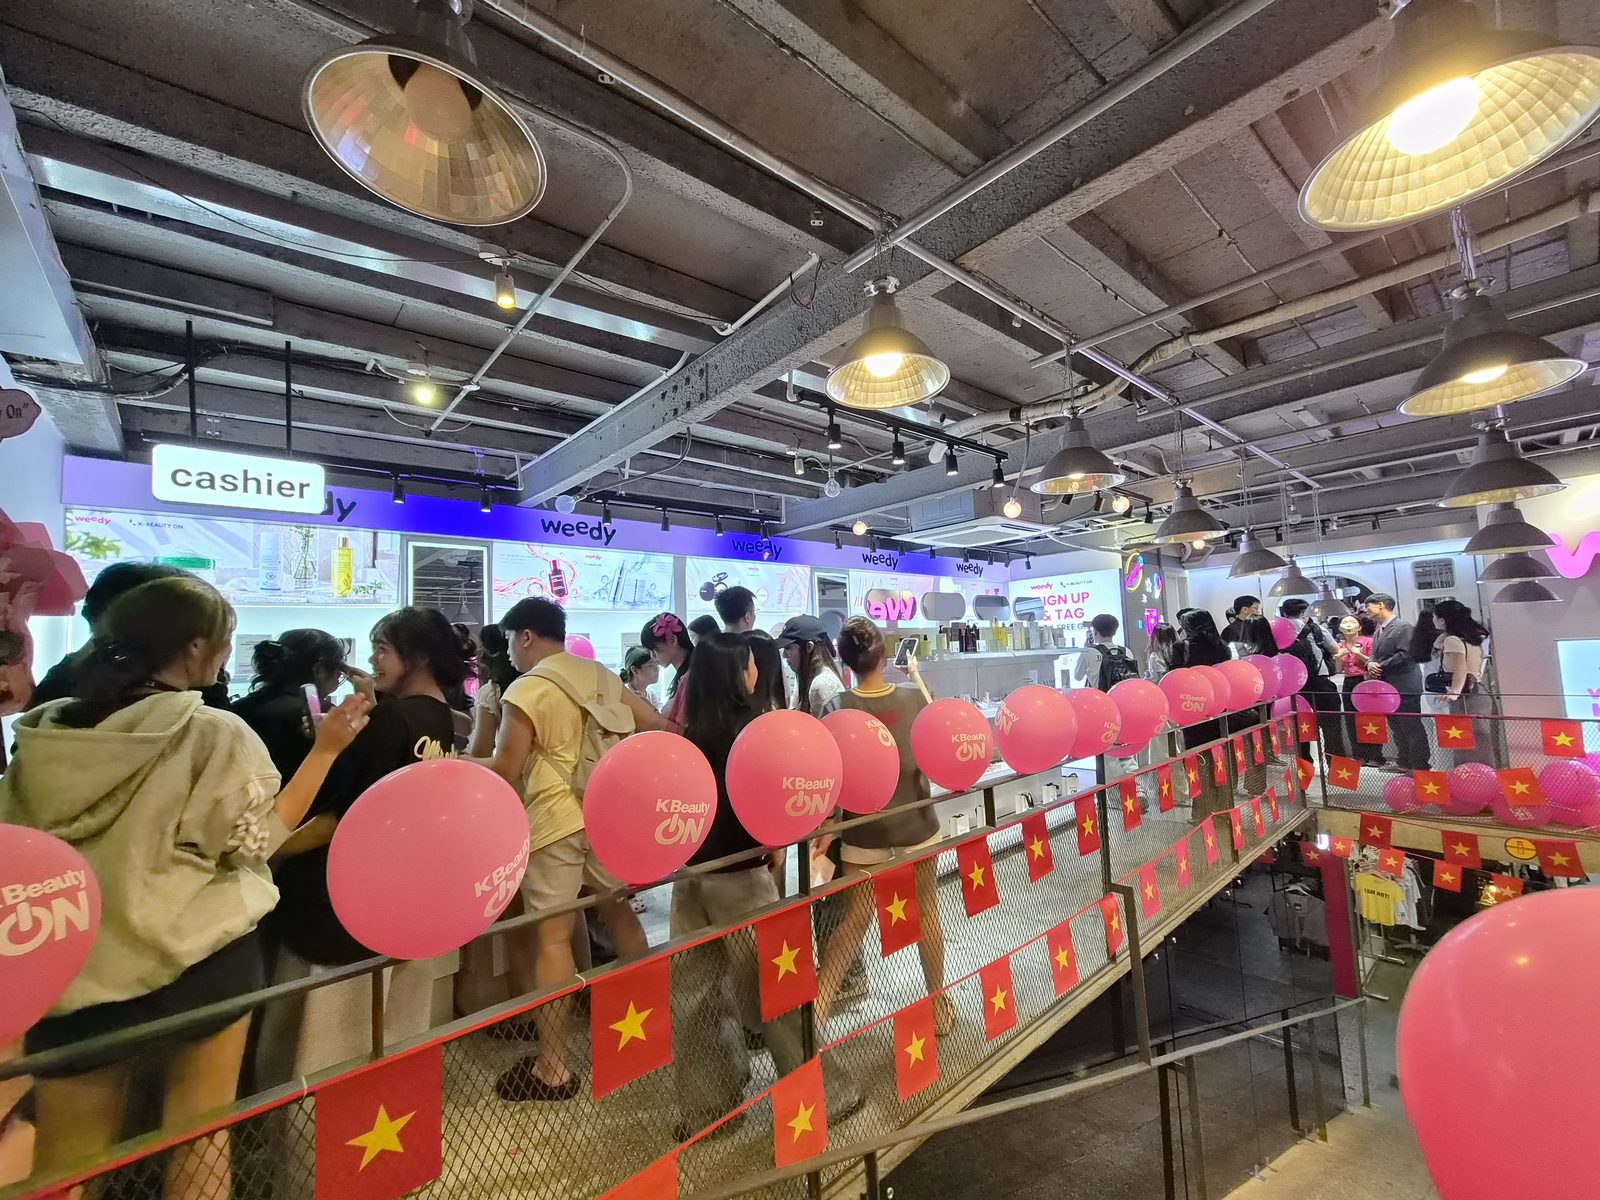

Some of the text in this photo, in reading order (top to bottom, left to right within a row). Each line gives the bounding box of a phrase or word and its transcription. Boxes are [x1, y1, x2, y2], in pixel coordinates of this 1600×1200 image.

[170, 468, 311, 499] cashier
[75, 515, 112, 525] weedy
[541, 518, 616, 546] weedy
[731, 539, 782, 560] weedy
[862, 553, 898, 570] weedy
[956, 562, 984, 578] weedy
[1030, 582, 1053, 590] weedy
[1043, 591, 1090, 606] IGN UP
[1055, 608, 1085, 620] TAG
[956, 742, 986, 762] ON
[785, 790, 830, 817] ON
[654, 813, 705, 846] ON
[0, 869, 86, 909] Beauty
[0, 890, 89, 956] ON
